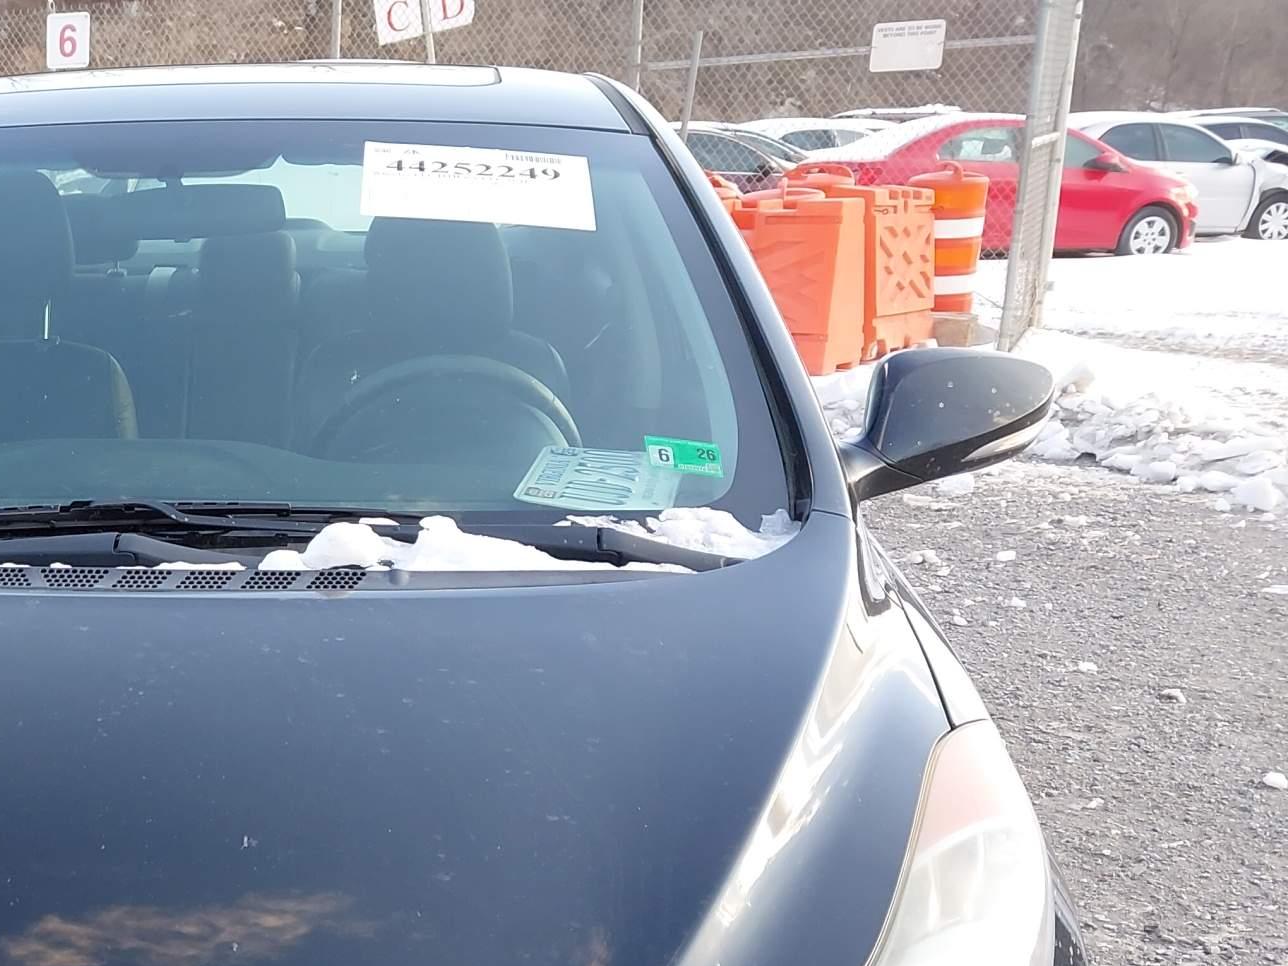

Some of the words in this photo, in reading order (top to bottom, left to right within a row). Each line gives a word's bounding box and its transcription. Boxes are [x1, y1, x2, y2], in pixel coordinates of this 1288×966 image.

[387, 0, 409, 31] C
[59, 24, 77, 57] 6
[386, 159, 561, 180] 44252249
[658, 448, 670, 463] 6
[696, 447, 716, 462] 26
